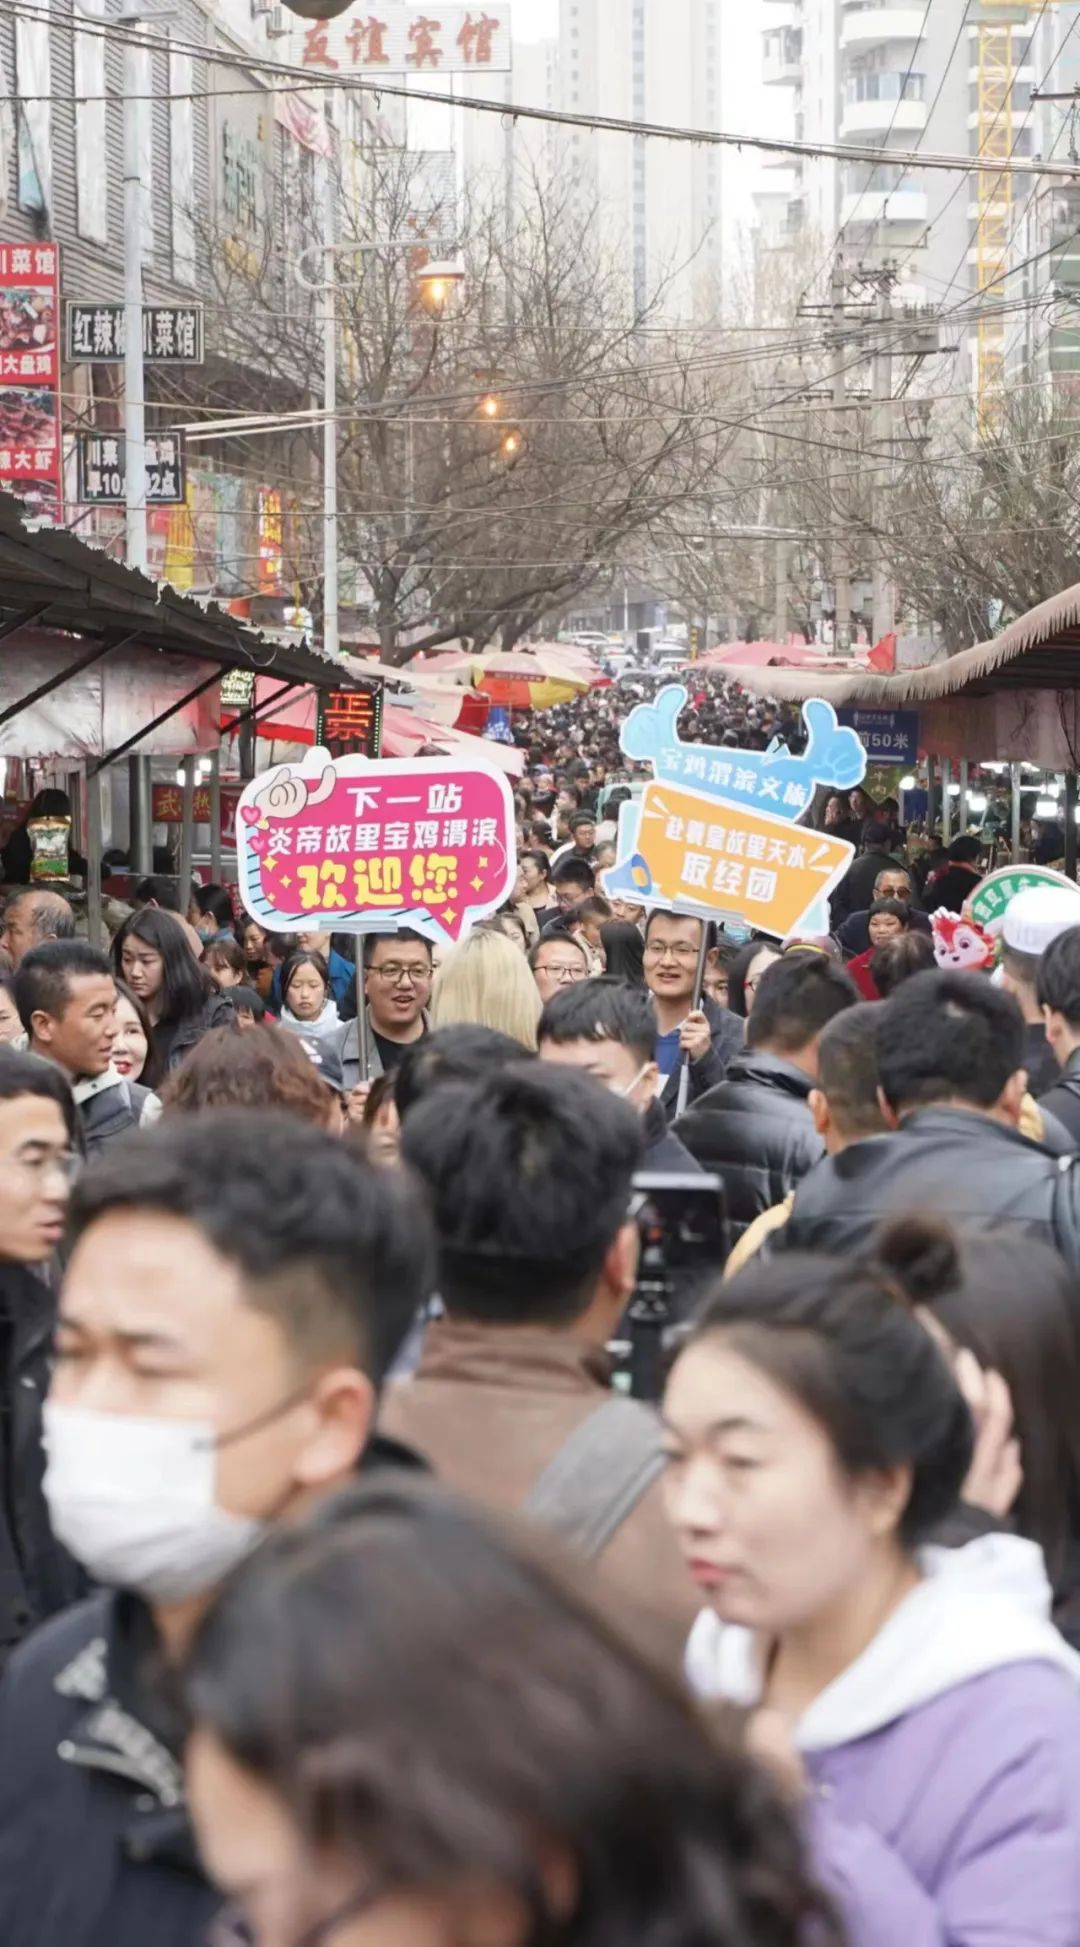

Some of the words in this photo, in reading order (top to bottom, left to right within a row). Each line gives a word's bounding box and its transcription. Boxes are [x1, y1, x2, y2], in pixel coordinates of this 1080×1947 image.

[303, 12, 500, 70] 友谊宾馆
[0, 354, 52, 375] 大盘鸡
[346, 783, 464, 818] 下一站
[661, 747, 809, 808] 宝鸡渭滨文旅
[267, 817, 498, 856] 炎帝故里宝鸡渭滨
[297, 853, 459, 910] 欢迎您
[680, 851, 778, 903] 取经团
